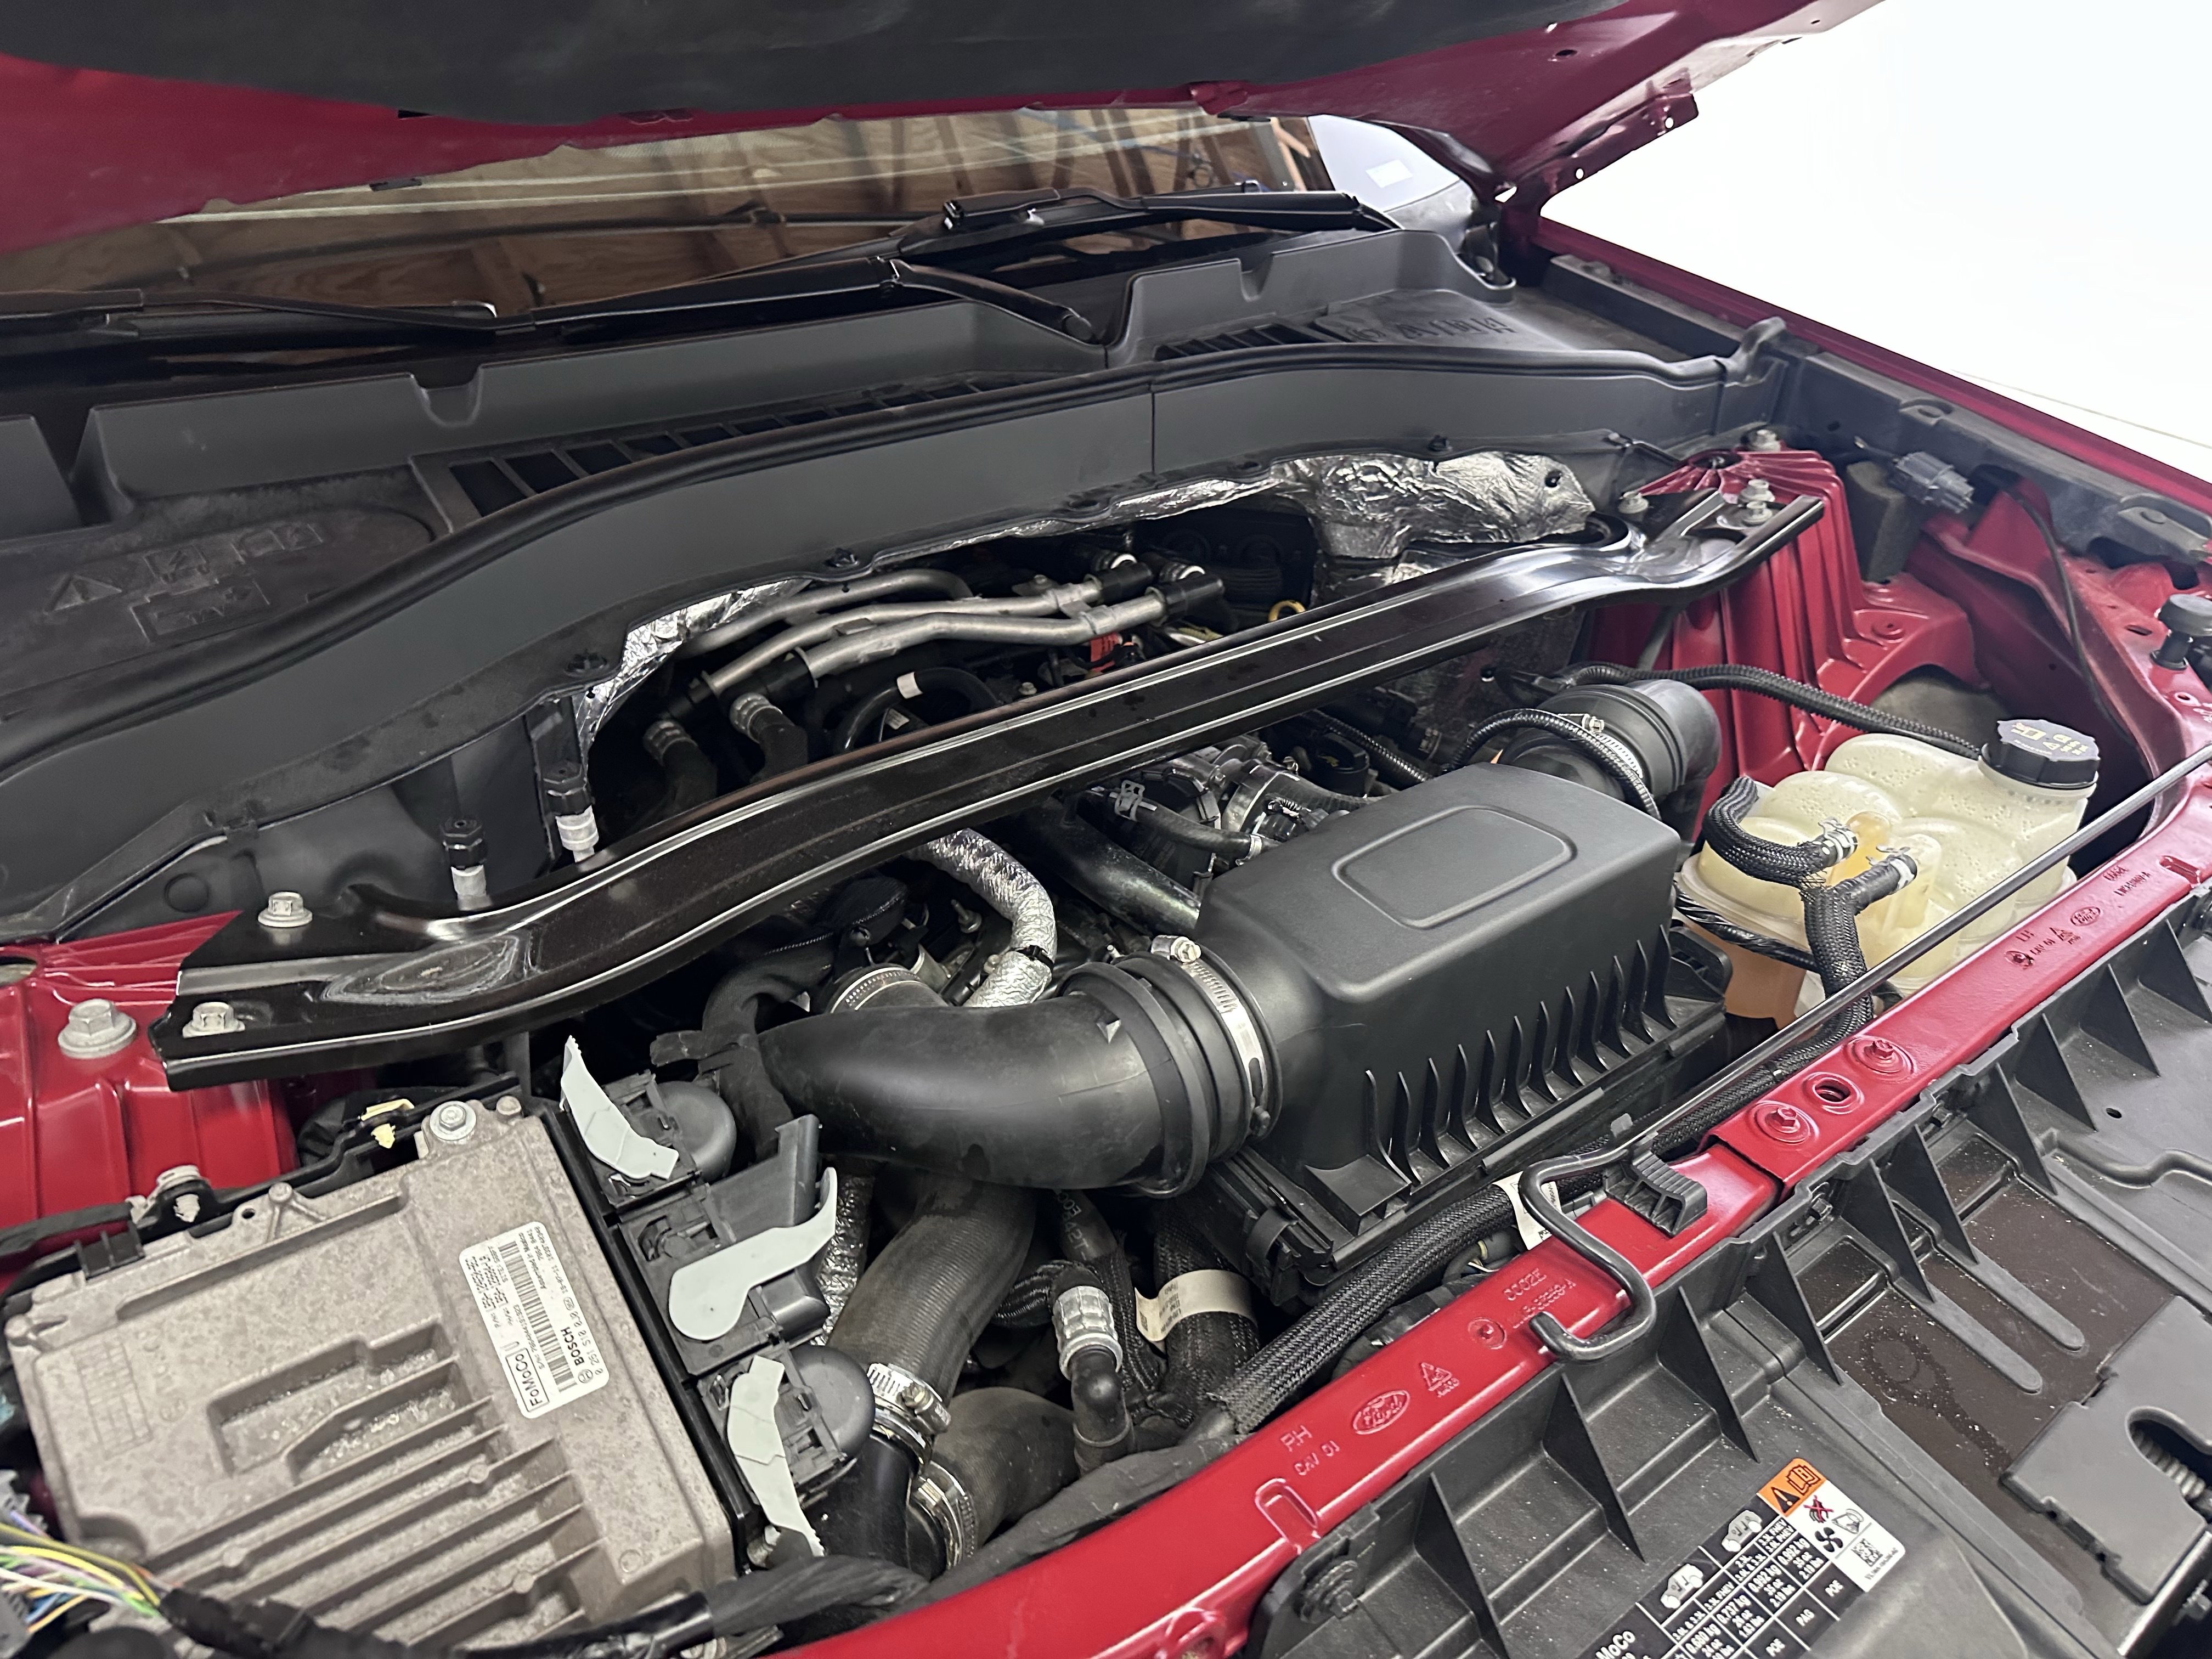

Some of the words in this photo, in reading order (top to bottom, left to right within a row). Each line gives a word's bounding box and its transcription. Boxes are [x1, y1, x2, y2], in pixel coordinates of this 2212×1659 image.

[561, 1327, 584, 1366] BOSCH
[516, 1354, 543, 1406] FoMoCo
[1355, 1392, 1408, 1430] Ford
[1280, 1426, 1312, 1452] RH
[1778, 1544, 1801, 1565] 0.992
[1793, 1538, 1810, 1549] kg
[1793, 1557, 1804, 1568] 35
[1801, 1552, 1813, 1561] oz
[1748, 1571, 1771, 1593] 0.992
[1764, 1564, 1782, 1576] kg
[1764, 1584, 1776, 1596] 35
[1773, 1578, 1784, 1588] oz
[1825, 1579, 1844, 1597] POE
[1733, 1595, 1751, 1607] kg
[1741, 1610, 1753, 1620] oz
[1796, 1609, 1815, 1626] PAG
[1672, 1627, 1688, 1640] 3.0L
[1703, 1623, 1721, 1637] kg
[1596, 1631, 1635, 1659] MoCo
[1711, 1639, 1723, 1649] oz
